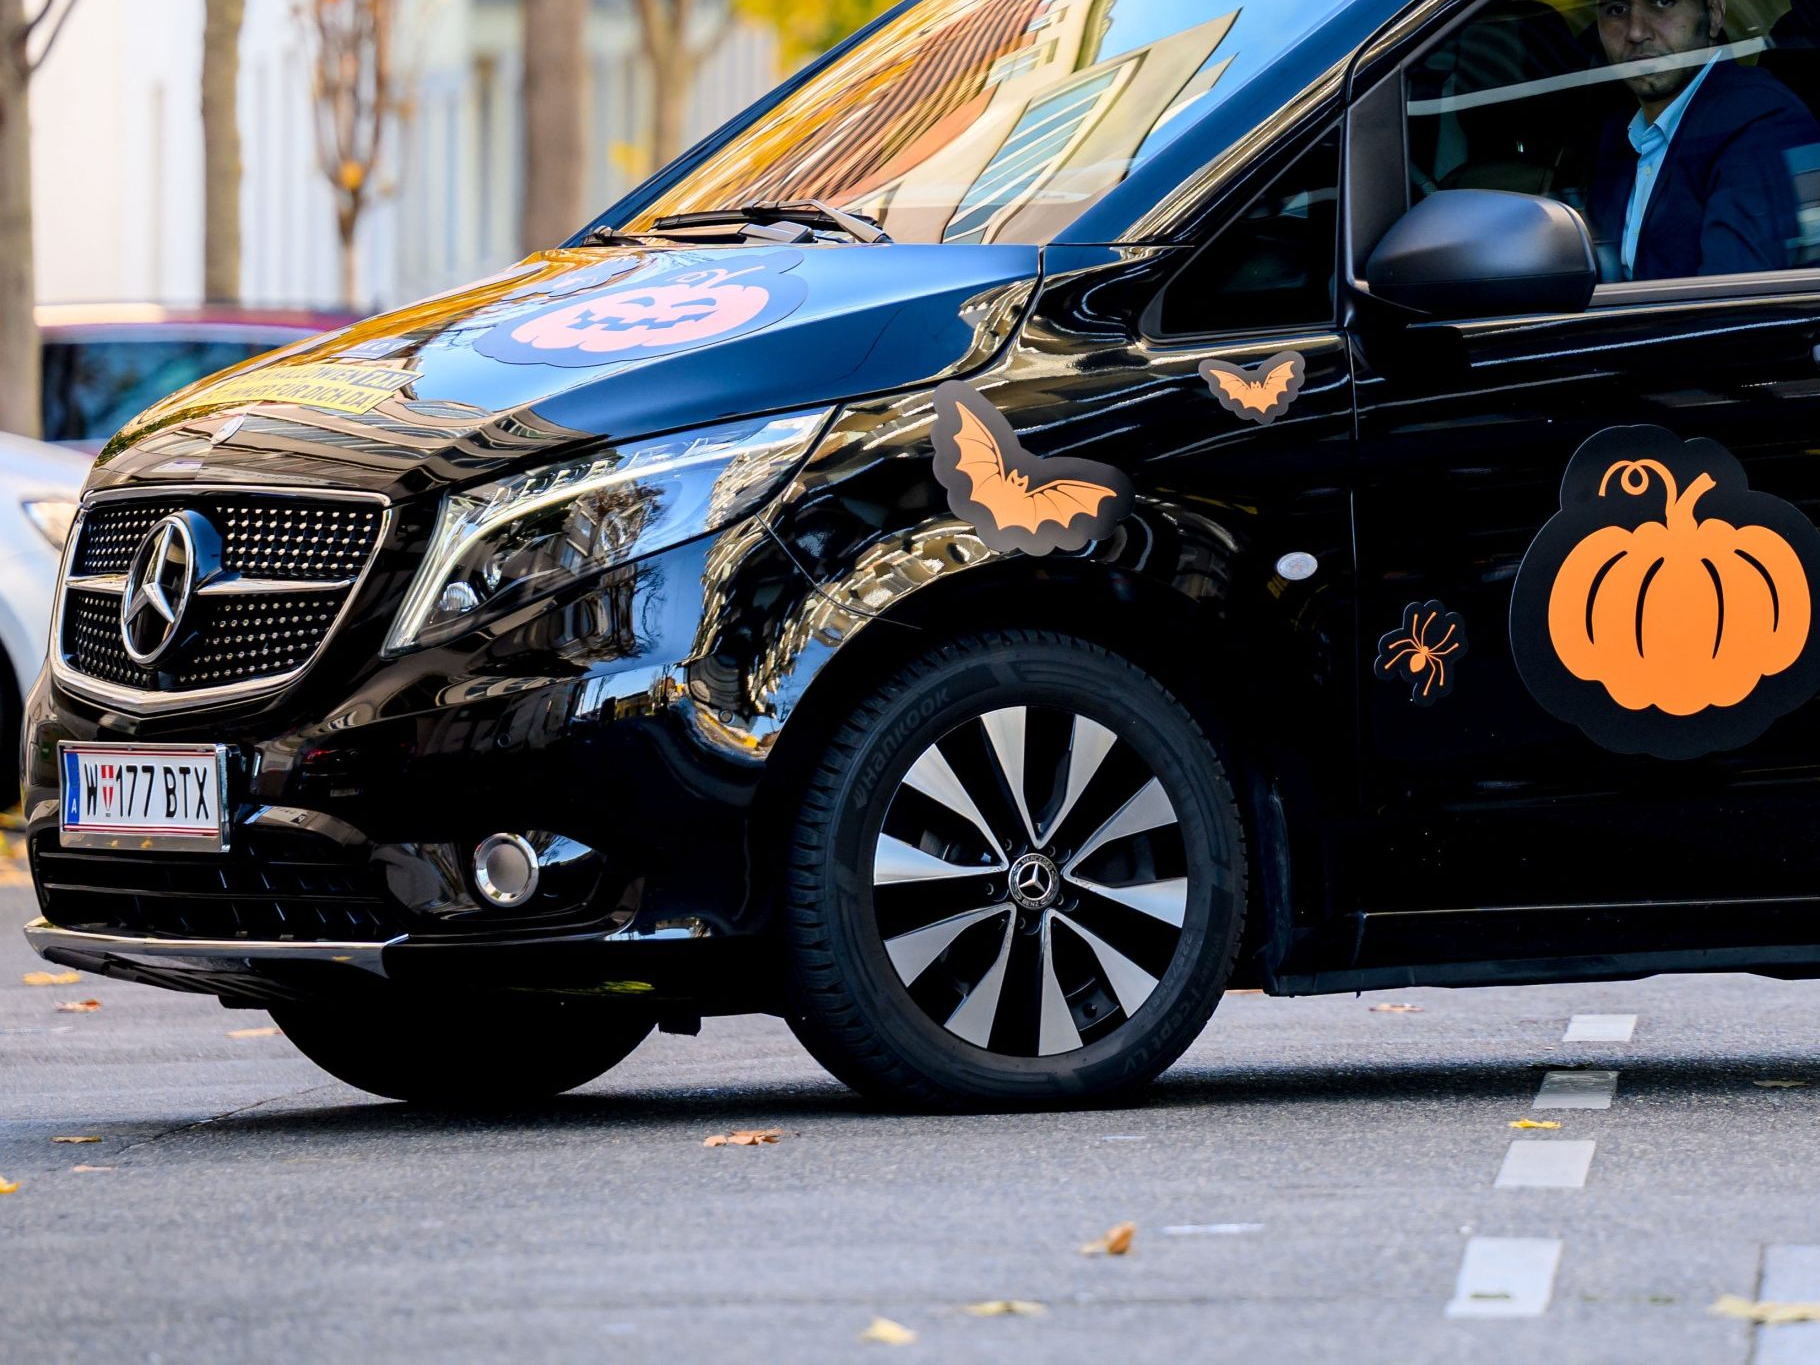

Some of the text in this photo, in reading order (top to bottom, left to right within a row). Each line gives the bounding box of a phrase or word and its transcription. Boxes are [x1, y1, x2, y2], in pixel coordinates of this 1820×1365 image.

[356, 371, 412, 390] TAXI
[298, 385, 354, 402] DICH
[339, 392, 385, 409] DA!
[84, 763, 209, 820] W 177 BTX
[70, 798, 78, 814] A
